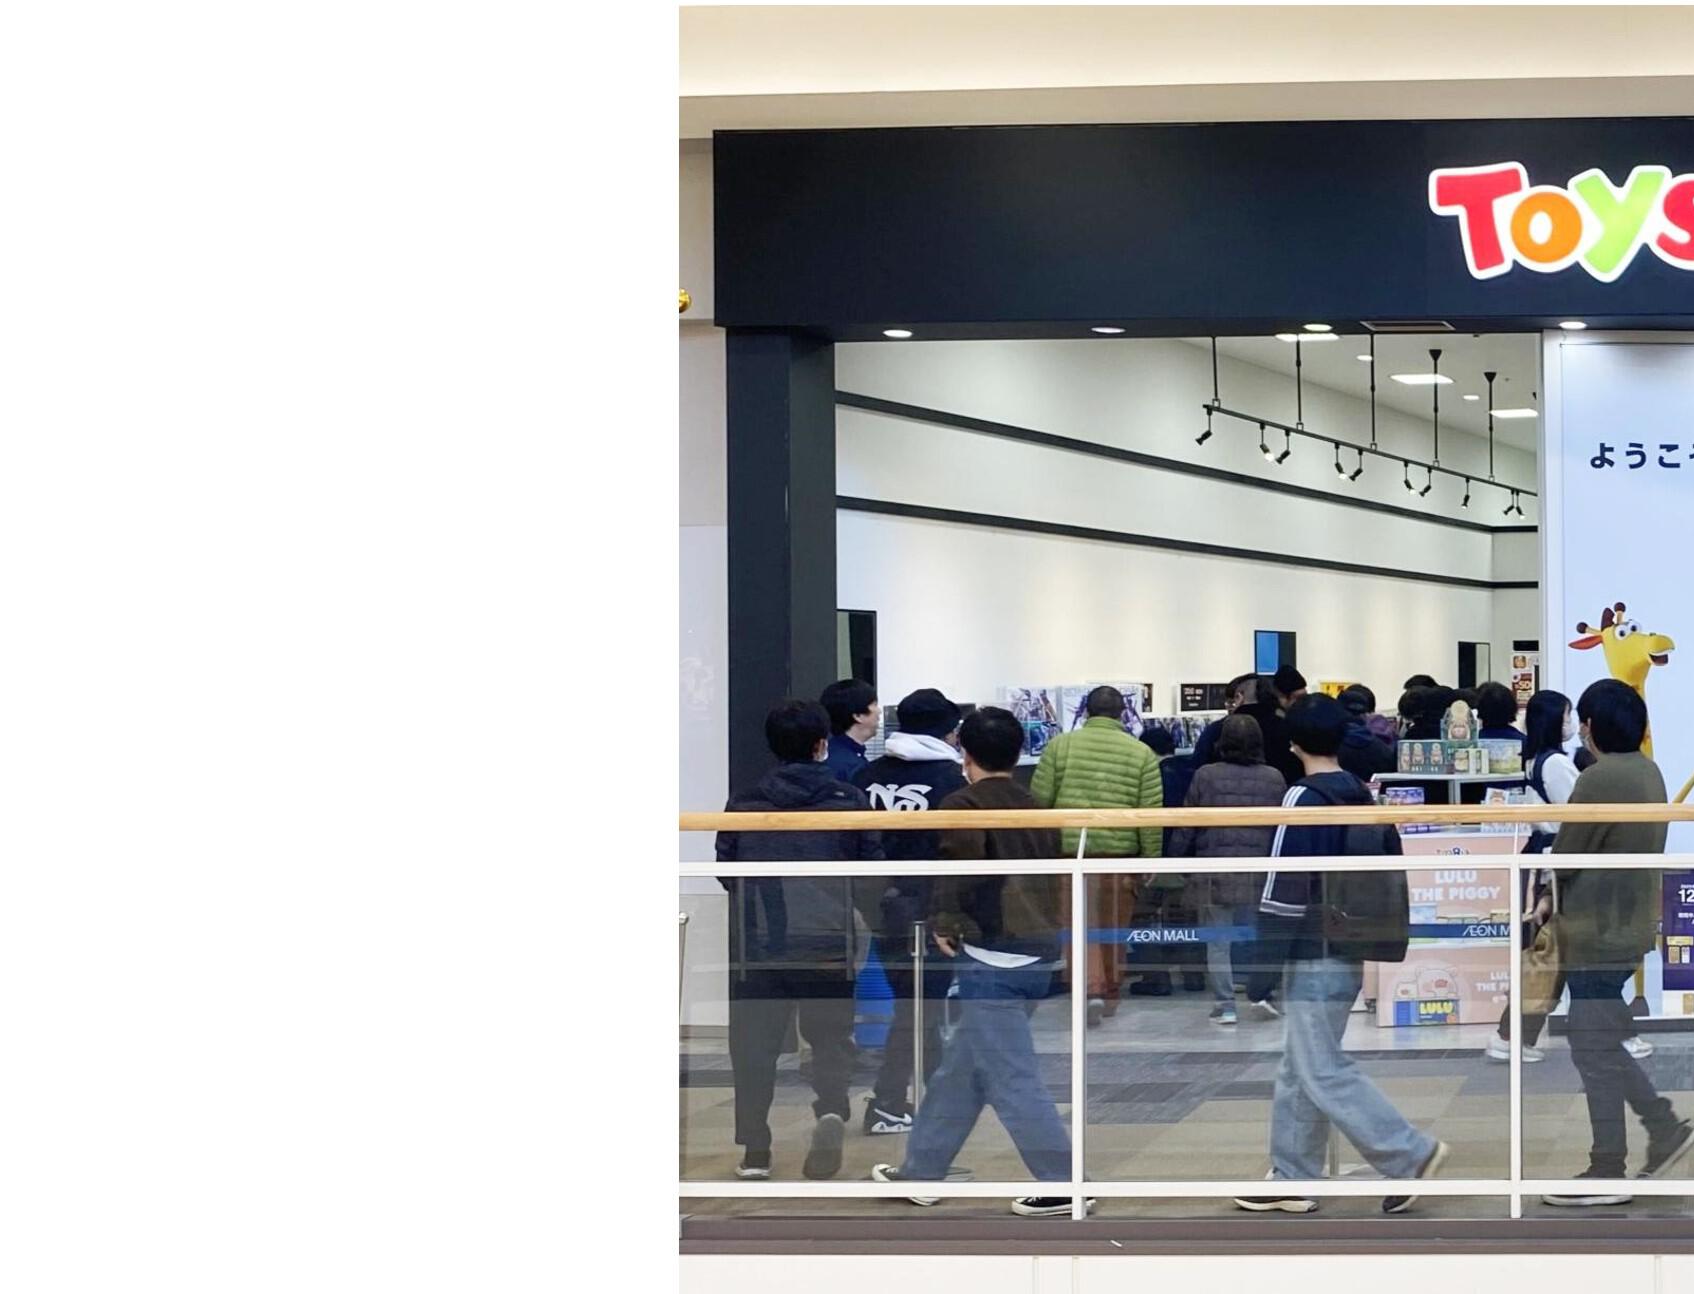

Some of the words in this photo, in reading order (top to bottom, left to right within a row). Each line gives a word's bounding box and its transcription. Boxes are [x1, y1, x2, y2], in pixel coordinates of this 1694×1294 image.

[1435, 870, 1477, 884] LULU
[1411, 887, 1443, 900] THE
[1449, 886, 1501, 900] PIGGY
[1163, 930, 1199, 941] MALL
[1490, 971, 1511, 980] LUL
[1419, 1001, 1453, 1014] LULU
